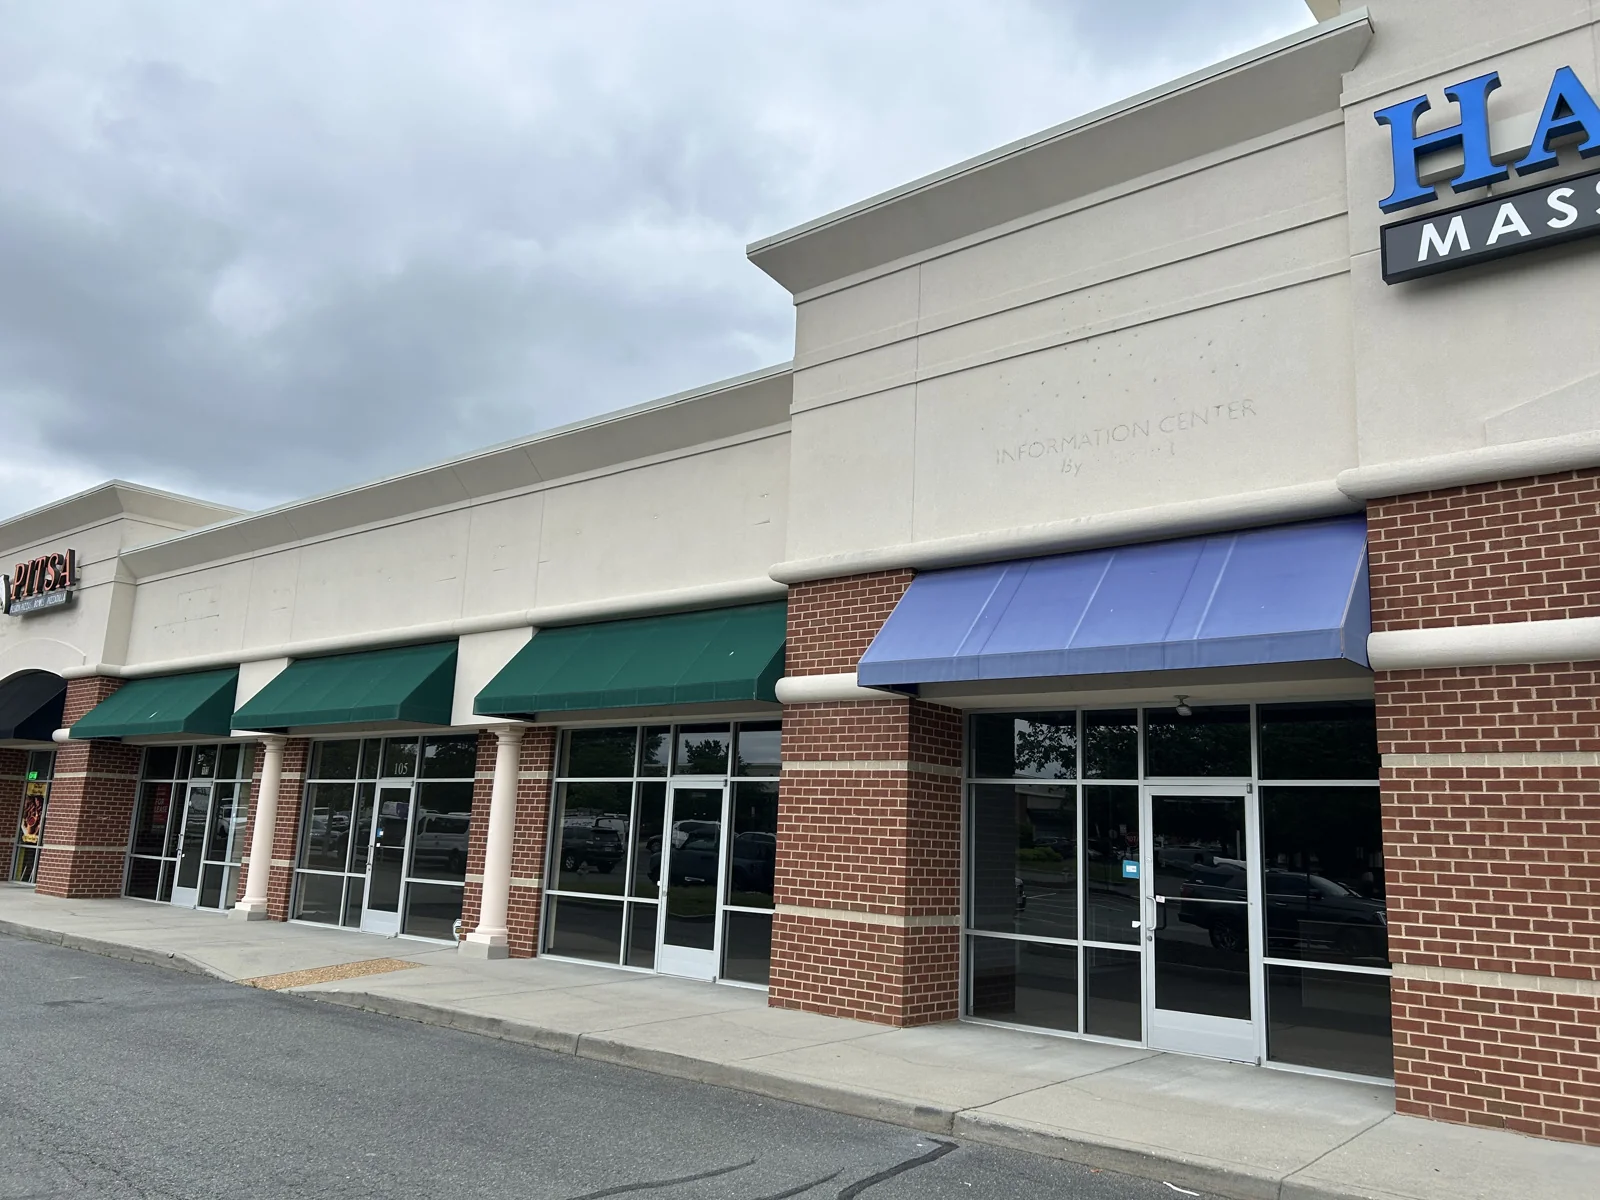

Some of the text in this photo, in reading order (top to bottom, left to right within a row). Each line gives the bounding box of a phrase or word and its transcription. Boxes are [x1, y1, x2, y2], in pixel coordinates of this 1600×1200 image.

[1417, 179, 1600, 262] MAS
[996, 420, 1150, 465] INFORMATION
[1158, 399, 1257, 434] CENTER
[11, 549, 75, 600] PITSA
[394, 762, 409, 775] 105
